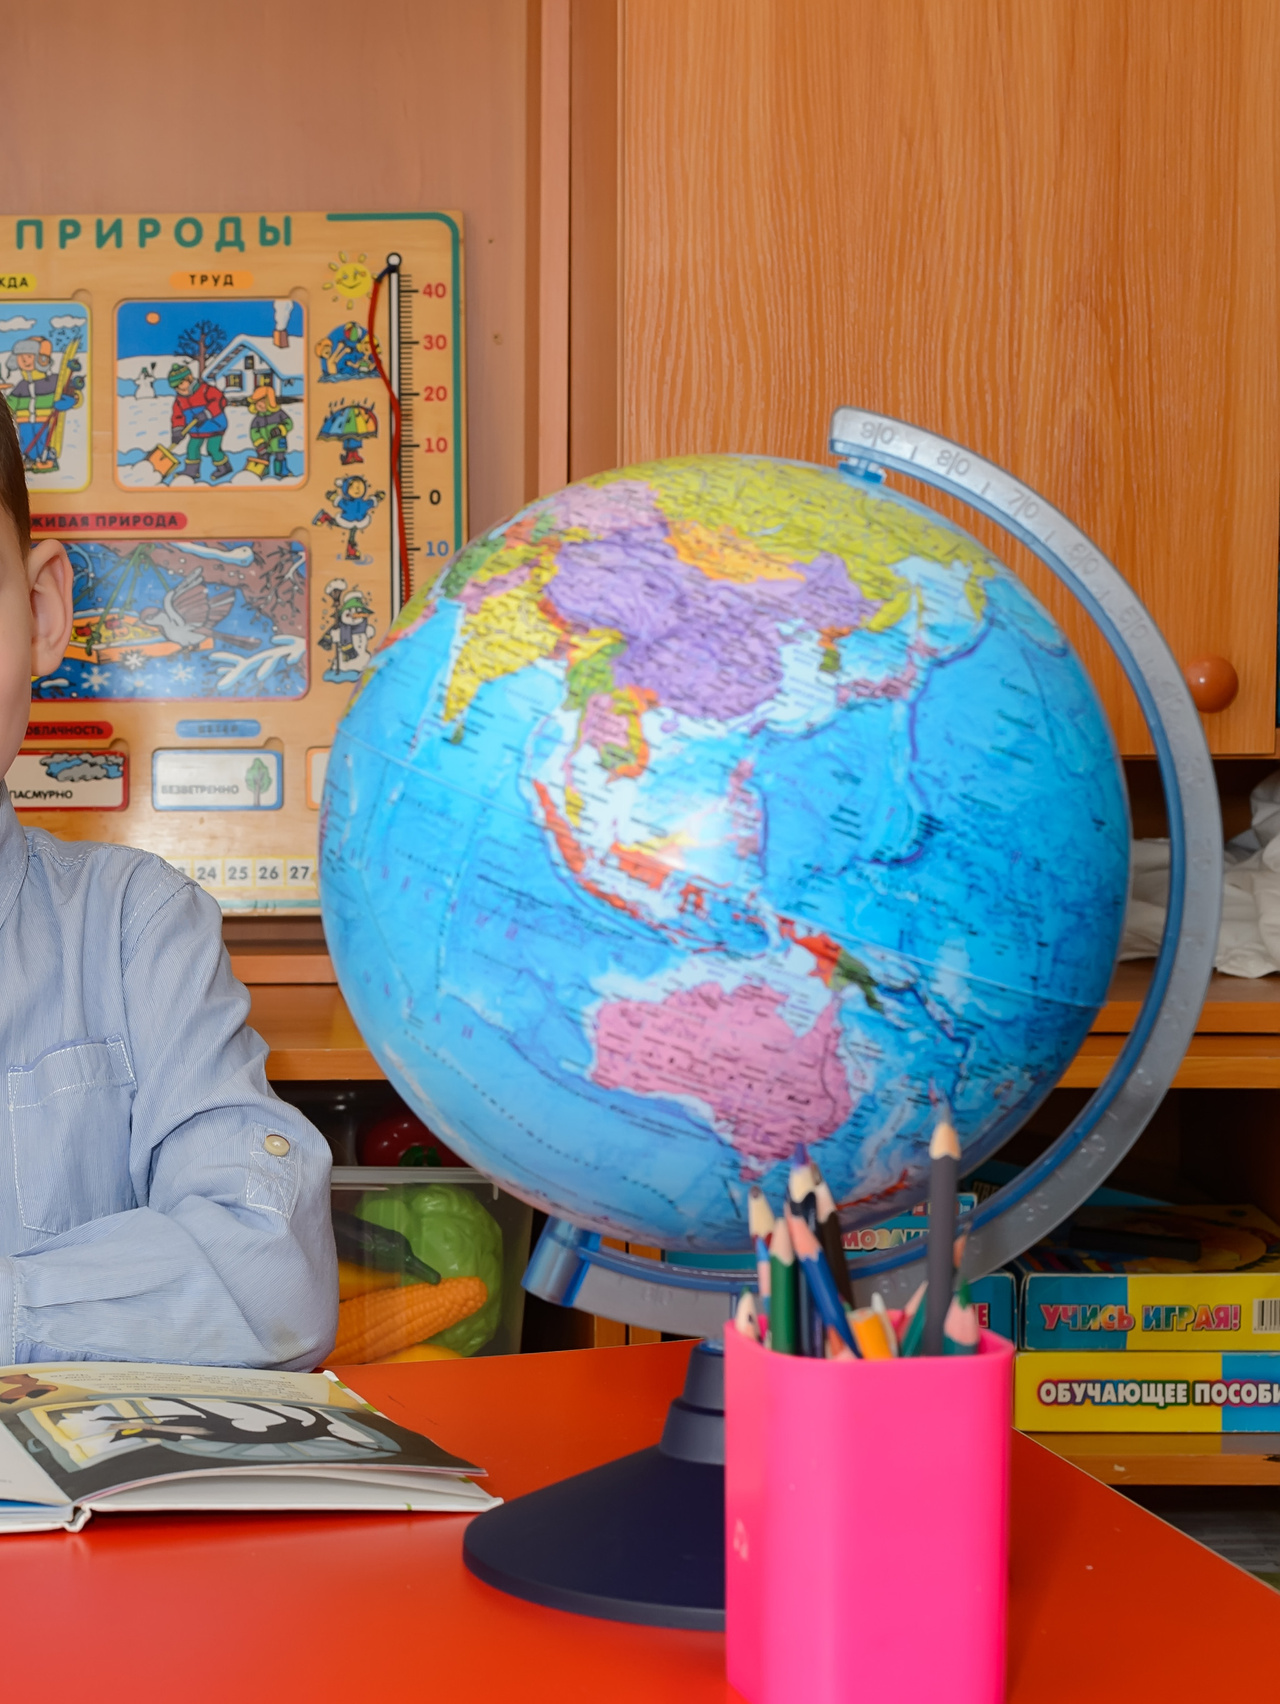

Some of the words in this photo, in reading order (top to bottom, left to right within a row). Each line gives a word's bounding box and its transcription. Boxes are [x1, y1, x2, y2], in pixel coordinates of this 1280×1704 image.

[16, 215, 291, 252] ПРИРОДЫ
[189, 275, 234, 287] ТРУД
[422, 283, 447, 299] 40
[423, 335, 448, 351] 30
[424, 386, 448, 402] 20
[424, 437, 448, 453] 10
[429, 489, 441, 505] 0
[95, 514, 178, 528] ПРИРОДА
[426, 541, 449, 557] 10
[10, 790, 73, 800] ПАСМУРНО
[161, 784, 239, 795] БЕЗВЕТРЕННО
[197, 866, 217, 880] 24
[228, 866, 248, 880] 25
[258, 866, 278, 880] 26
[290, 866, 310, 879] 27
[1039, 1302, 1135, 1332] УЧИСЬ
[1142, 1303, 1241, 1331] ИГРАЯ!
[1039, 1381, 1188, 1408] ОБУЧАЮЩЕЕ
